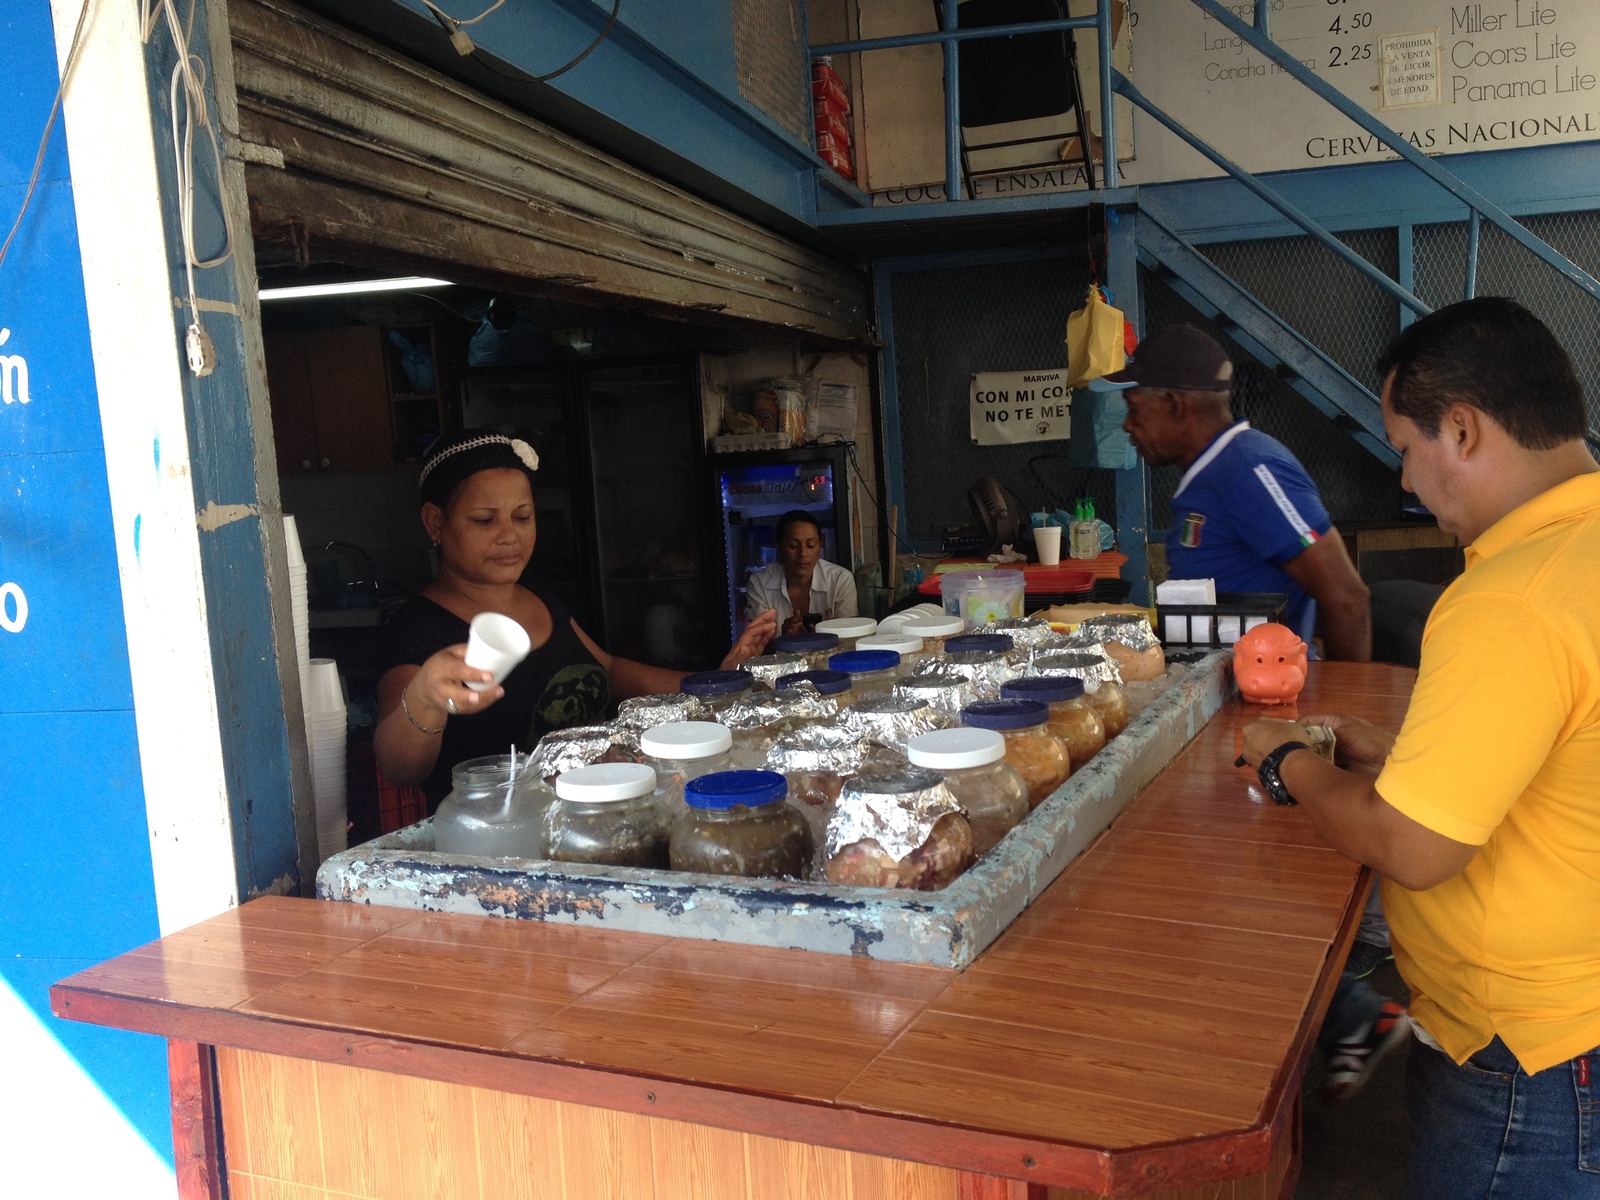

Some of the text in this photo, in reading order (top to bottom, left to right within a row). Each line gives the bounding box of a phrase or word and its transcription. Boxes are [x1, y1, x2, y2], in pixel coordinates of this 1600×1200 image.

[1329, 12, 1372, 35] 4.50
[1451, 0, 1556, 35] Miller Lite
[1385, 38, 1432, 51] PROHIBIDA
[1451, 32, 1576, 69] Coors Lite
[1205, 59, 1266, 81] Concha
[1328, 43, 1373, 67] 2.25
[1401, 50, 1431, 60] VENTA
[1404, 61, 1431, 71] LICOR
[1393, 72, 1435, 84] MENORES
[1452, 65, 1596, 104] Panama Lite
[1404, 85, 1429, 94] EDAD
[1447, 113, 1600, 145] NACIONAL
[1023, 373, 1060, 383] MARVIVA
[976, 391, 1009, 404] CON
[1016, 390, 1035, 403] MI
[985, 410, 1009, 423] NO
[1015, 408, 1034, 421] TE
